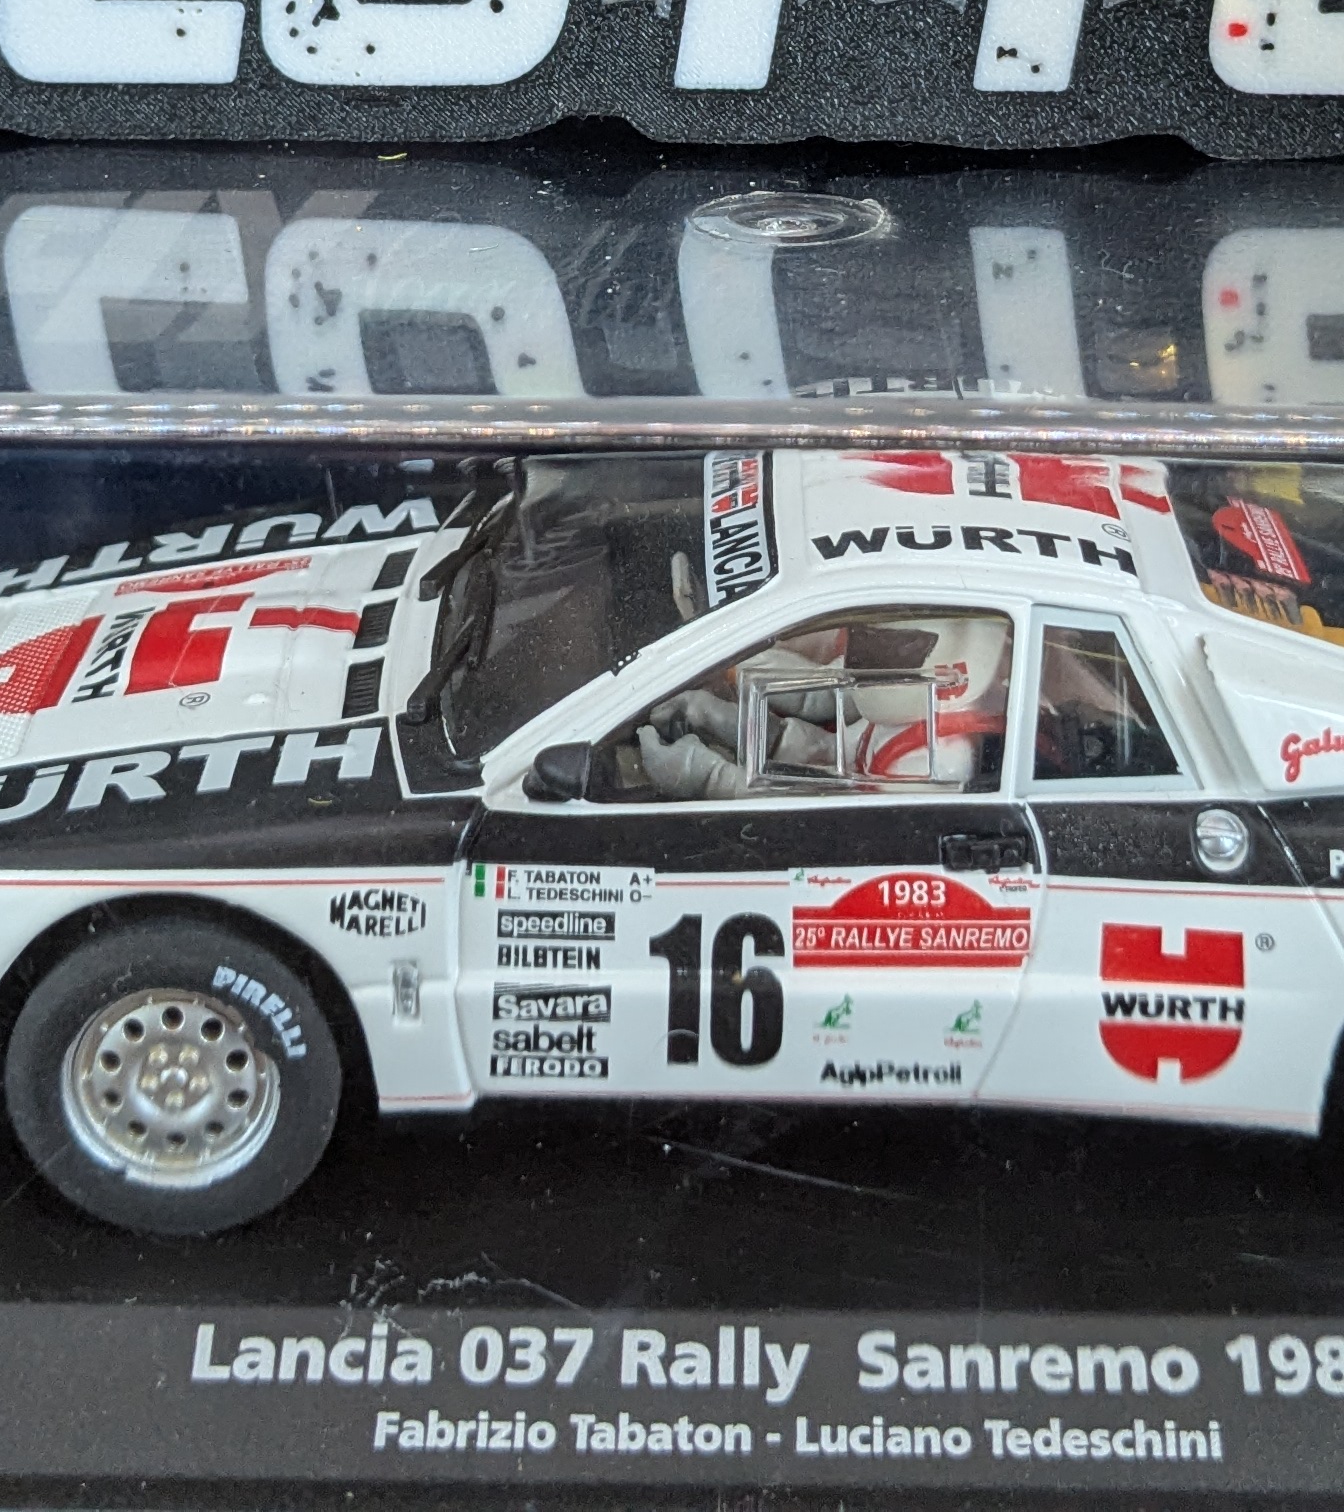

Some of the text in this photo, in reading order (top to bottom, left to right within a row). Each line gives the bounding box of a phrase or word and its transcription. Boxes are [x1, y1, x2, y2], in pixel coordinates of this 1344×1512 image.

[710, 504, 762, 607] LANCIA
[508, 869, 520, 884] F.
[524, 869, 601, 885] TABATON
[507, 886, 521, 900] L.
[526, 886, 623, 903] TEDESCHINI
[877, 879, 946, 906] 1983
[500, 911, 607, 937] speedline
[830, 926, 914, 949] RALLYE
[919, 926, 1028, 949] SANREMO
[648, 912, 786, 1068] 16
[212, 965, 307, 1060] PIRELLI
[497, 992, 608, 1019] Savara
[493, 1023, 597, 1054] sabelt
[190, 1322, 435, 1384] Lancia
[459, 1325, 595, 1385] 037
[621, 1325, 810, 1403] Rally
[856, 1329, 1201, 1394] Sanremo
[373, 1410, 557, 1453] Fabrizio
[571, 1411, 753, 1454] Tabaton
[795, 1415, 972, 1456] Luciano
[984, 1418, 1223, 1460] Tedeschini
